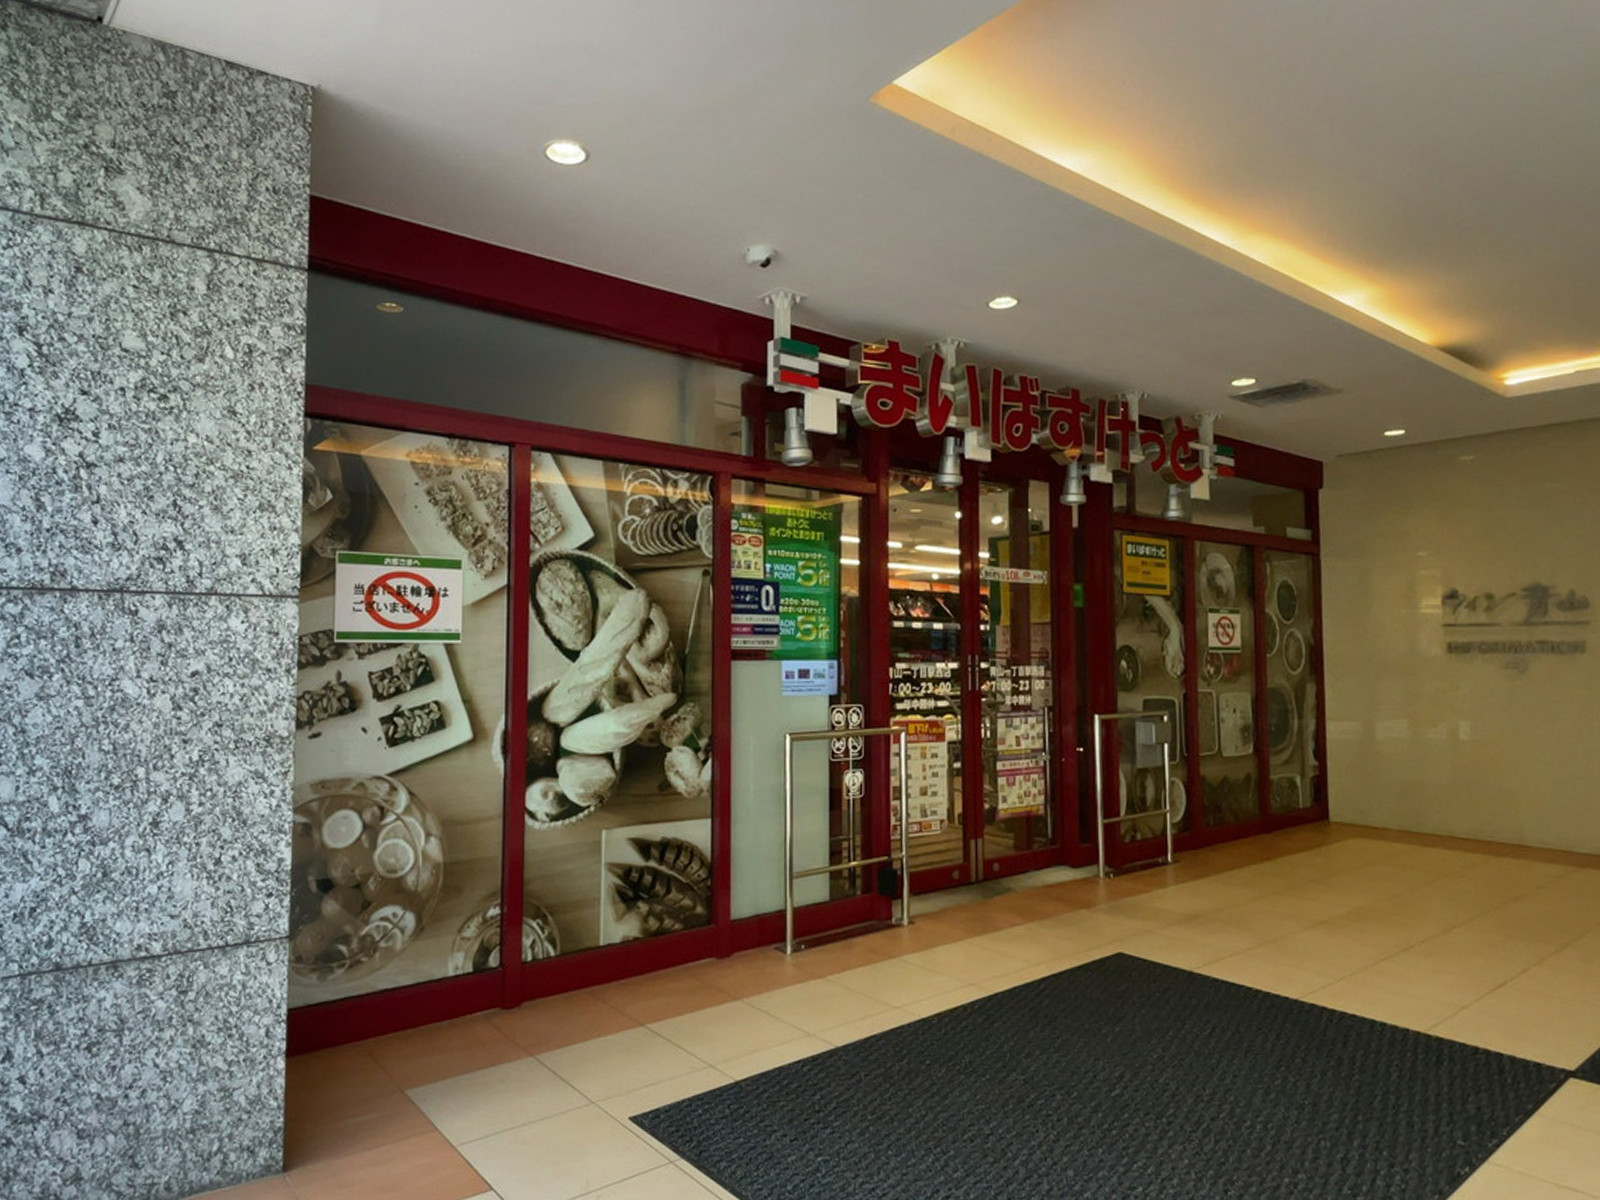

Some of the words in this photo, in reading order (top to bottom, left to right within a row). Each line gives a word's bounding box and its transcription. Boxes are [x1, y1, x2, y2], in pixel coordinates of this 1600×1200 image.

[857, 340, 1204, 485] まいばすけっと
